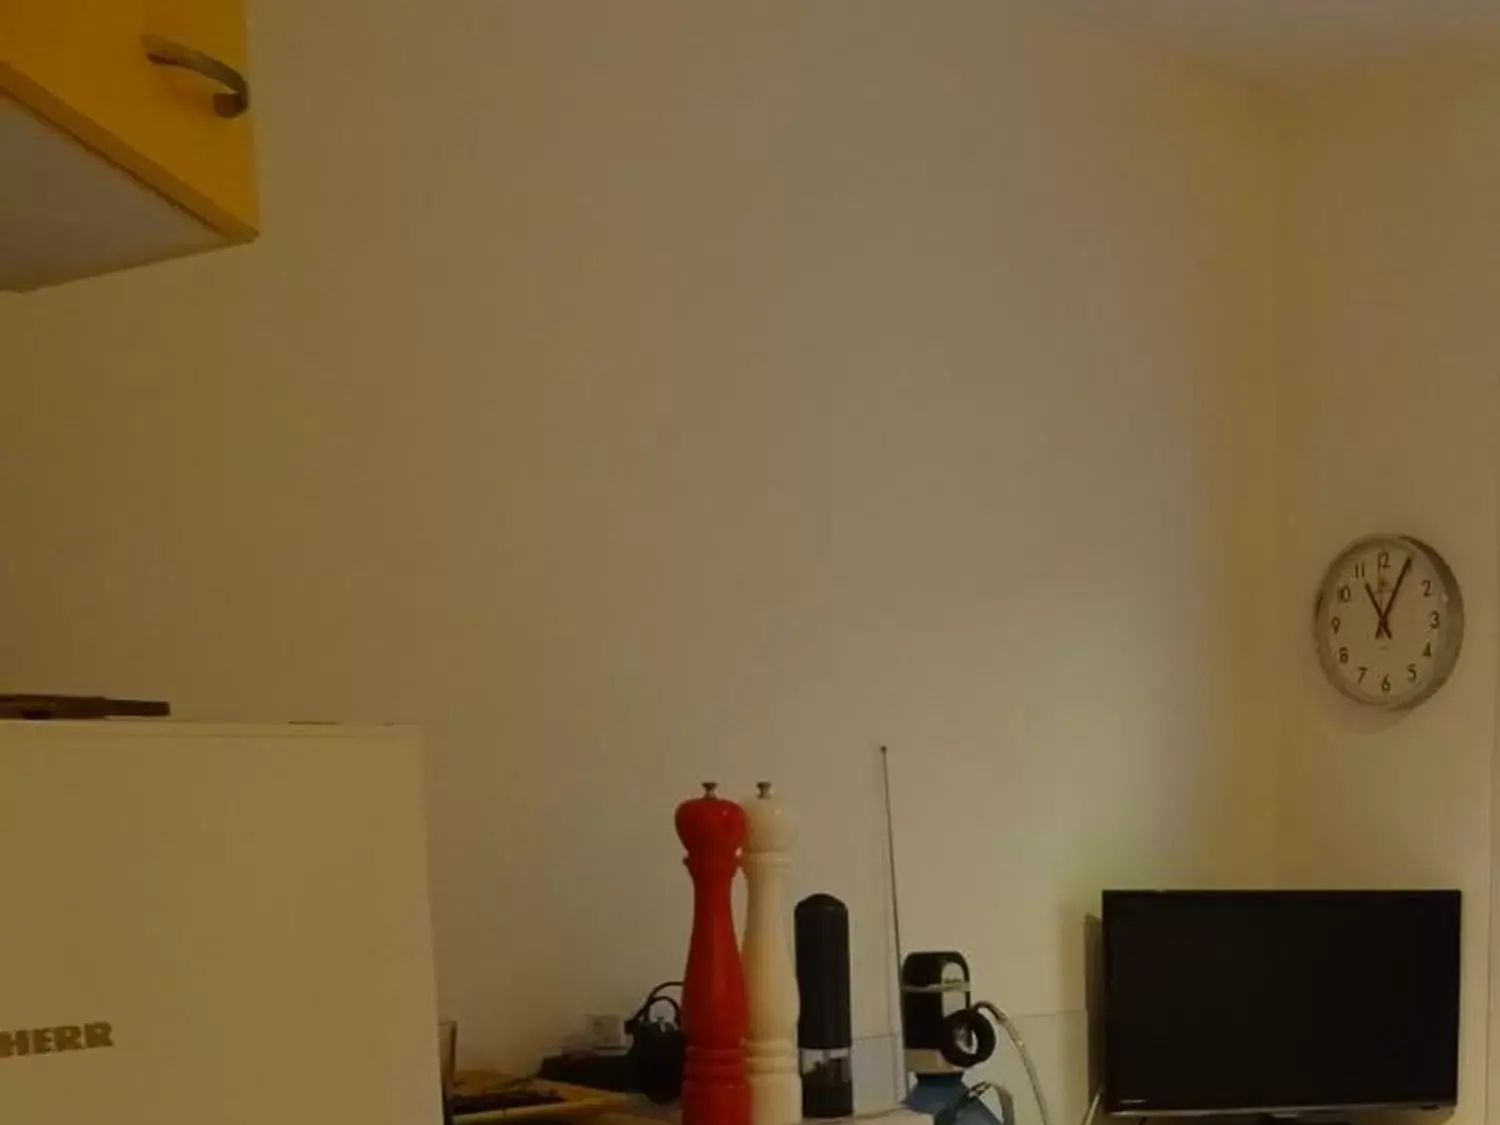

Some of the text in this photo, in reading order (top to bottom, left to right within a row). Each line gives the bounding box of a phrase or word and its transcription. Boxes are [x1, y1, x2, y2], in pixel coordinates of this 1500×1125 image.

[1378, 552, 1391, 568] 12
[1354, 563, 1365, 579] 11
[1339, 585, 1351, 602] 10
[1422, 580, 1432, 597] 2
[1331, 616, 1341, 634] 9
[1430, 611, 1441, 629] 3
[1339, 646, 1349, 663] 8
[1422, 642, 1432, 657] 4
[1357, 666, 1368, 683] 7
[1406, 663, 1417, 682] 5
[1381, 674, 1391, 692] 6
